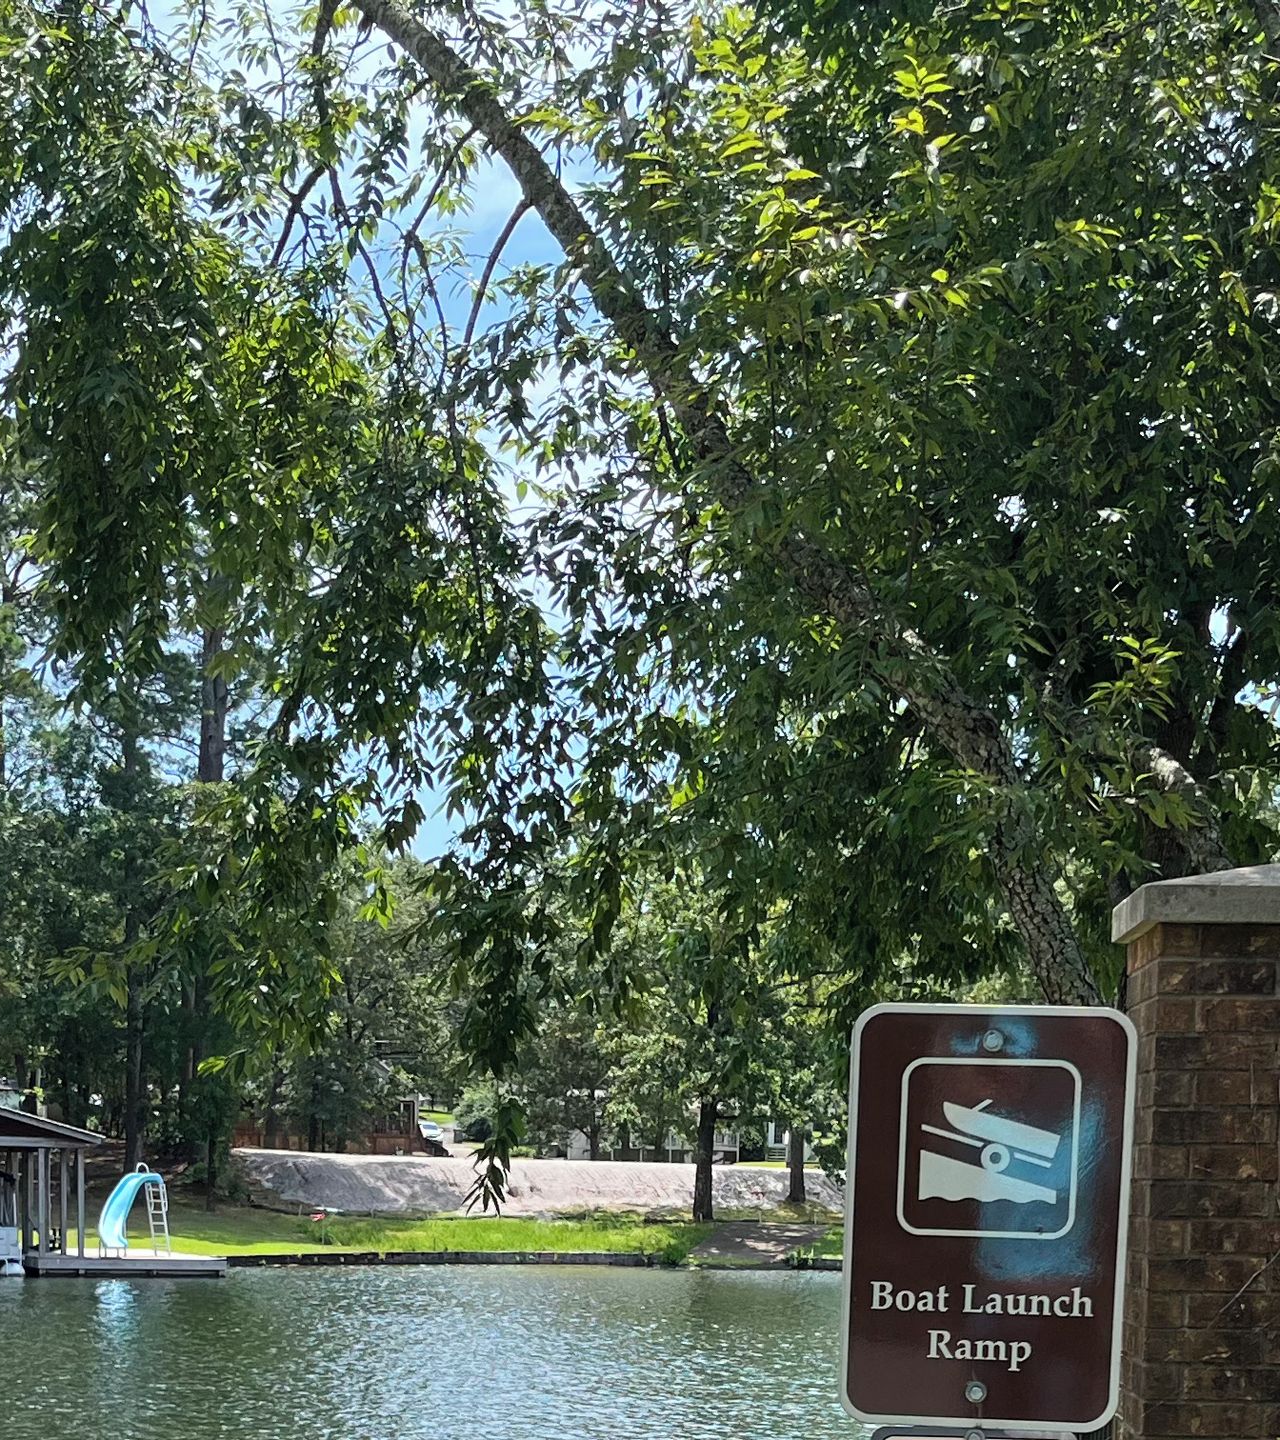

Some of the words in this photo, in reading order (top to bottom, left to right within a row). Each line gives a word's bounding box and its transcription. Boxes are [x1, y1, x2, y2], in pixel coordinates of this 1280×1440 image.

[870, 1280, 950, 1313] Boat
[961, 1283, 1095, 1318] Launch
[926, 1329, 1032, 1372] Ramp
